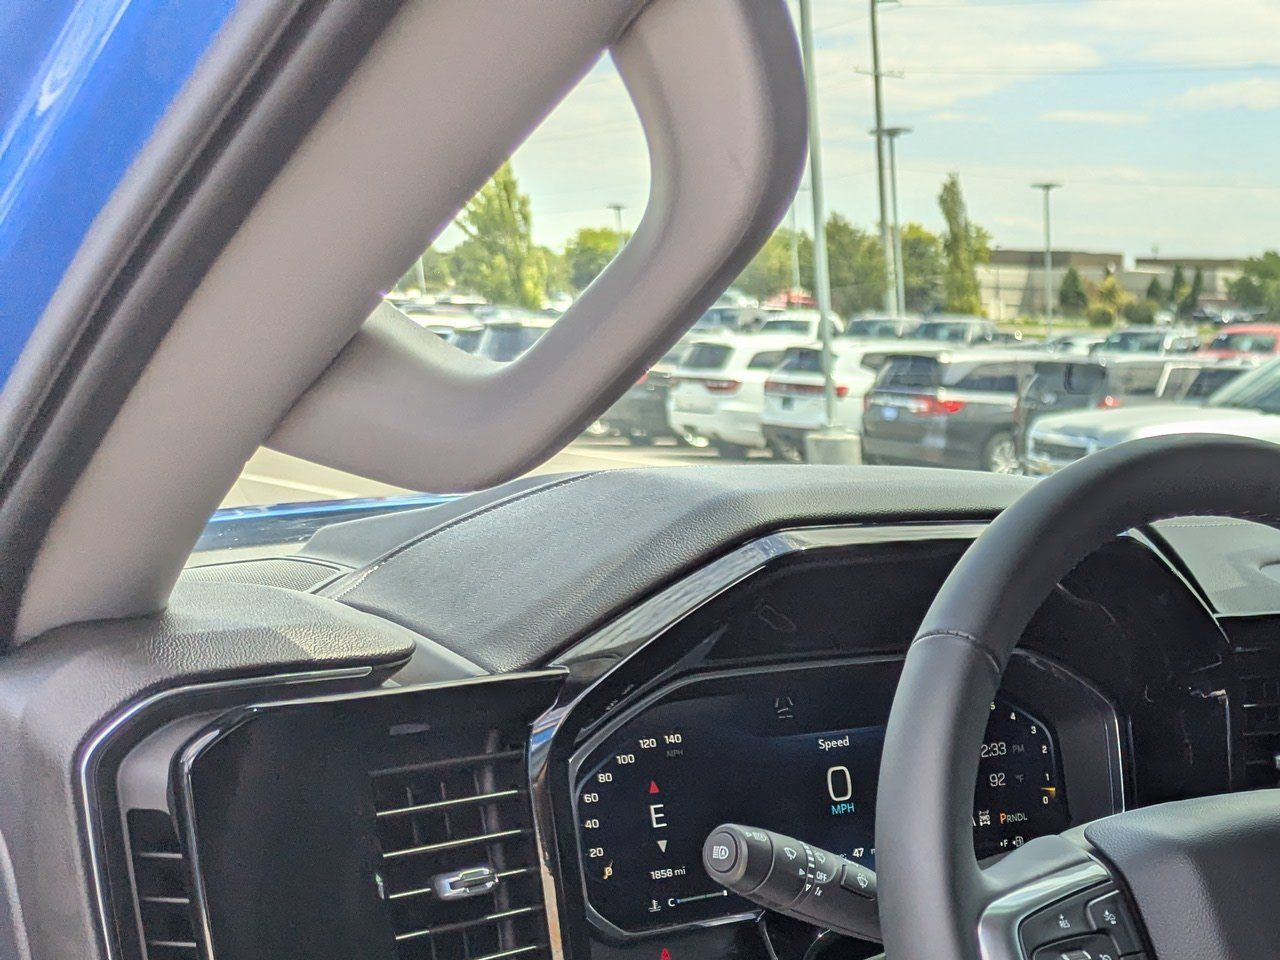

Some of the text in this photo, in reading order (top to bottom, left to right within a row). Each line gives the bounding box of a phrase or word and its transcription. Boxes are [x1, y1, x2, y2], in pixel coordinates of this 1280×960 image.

[1010, 712, 1016, 721] 4
[1030, 726, 1037, 735] 3
[639, 738, 657, 749] 120
[664, 733, 683, 745] 140
[818, 735, 850, 751] Speed
[1042, 745, 1048, 754] 2
[616, 753, 635, 765] 100
[598, 772, 613, 783] 80
[989, 772, 1006, 787] 92
[1045, 773, 1050, 782] 1
[827, 766, 852, 801] 0
[584, 793, 599, 804] 60
[1042, 796, 1049, 805] 0
[831, 803, 855, 815] MPH
[650, 804, 668, 828] E
[585, 818, 600, 830] 40
[589, 847, 604, 858] 20
[853, 847, 864, 857] 47
[651, 866, 686, 880] 1858 mi
[816, 871, 828, 881] OFF
[668, 898, 675, 908] C
